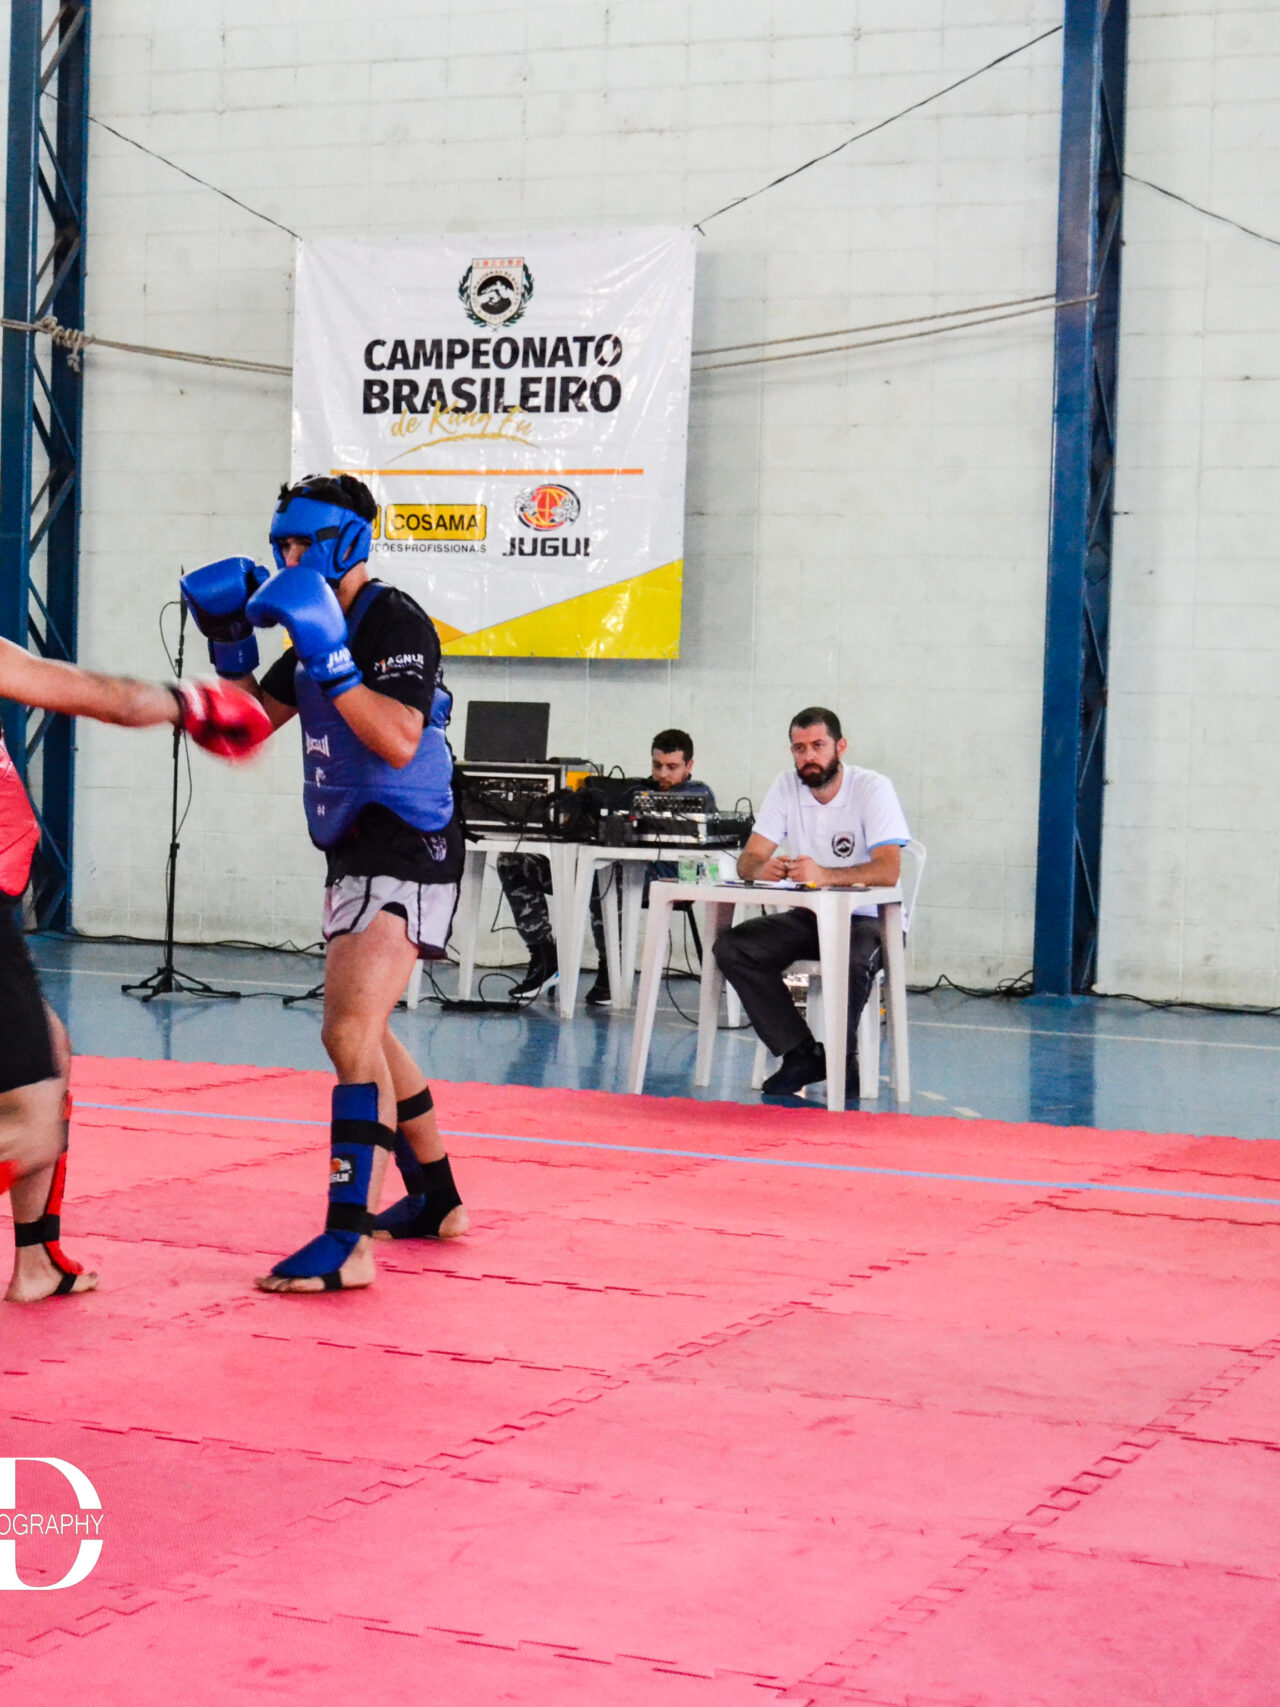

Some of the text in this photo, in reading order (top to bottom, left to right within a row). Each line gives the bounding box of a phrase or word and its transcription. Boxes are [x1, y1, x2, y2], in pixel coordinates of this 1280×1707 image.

[364, 333, 623, 371] CAMPEONATO
[362, 374, 622, 414] BRASILEIRO
[390, 399, 533, 438] de Kung Fu
[391, 513, 480, 532] COSAMA
[404, 543, 487, 554] PROFISSIONAS
[501, 537, 590, 557] JUGUI
